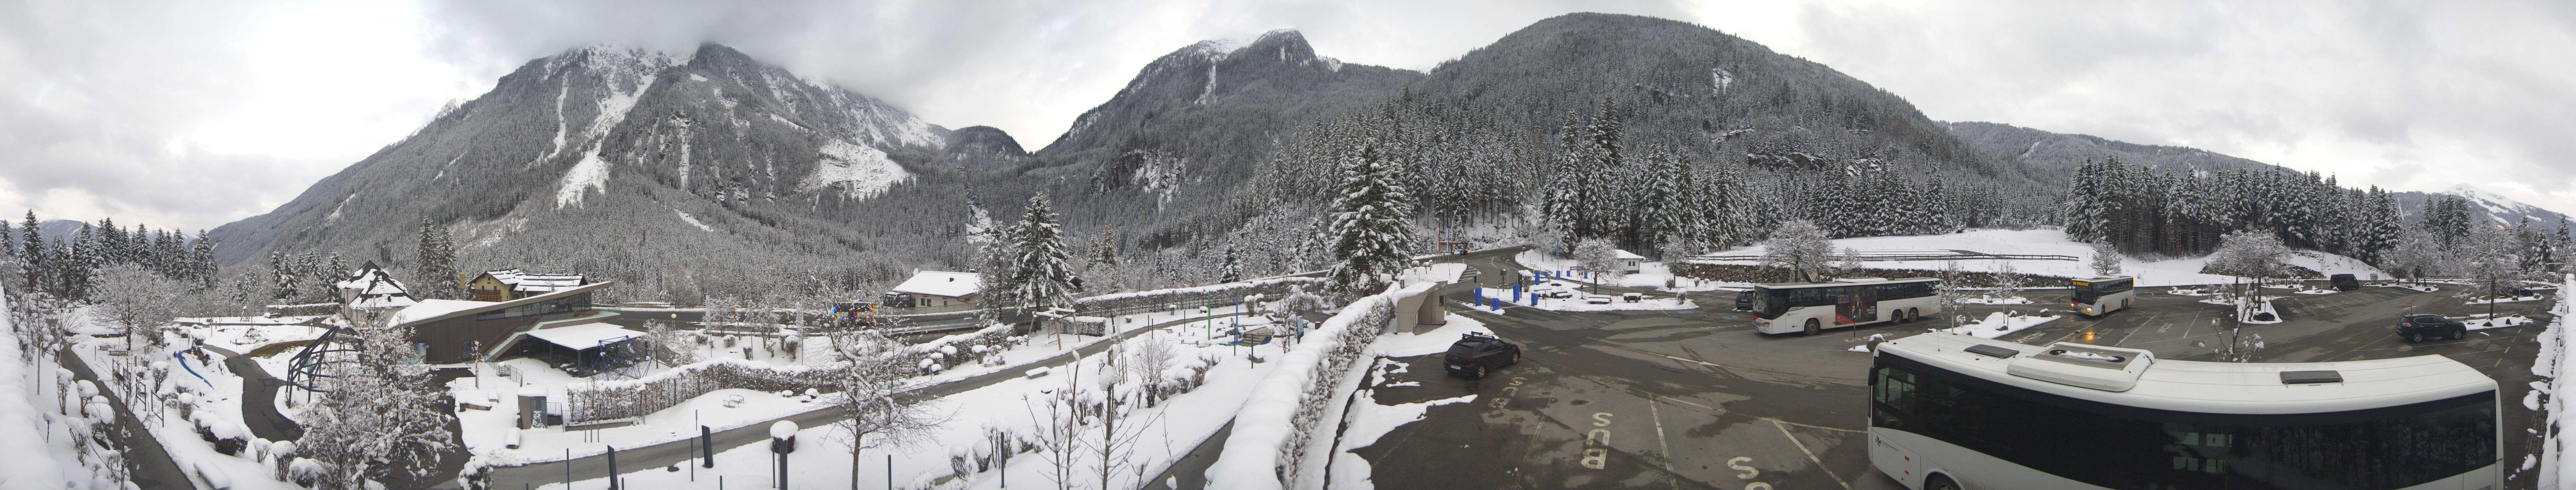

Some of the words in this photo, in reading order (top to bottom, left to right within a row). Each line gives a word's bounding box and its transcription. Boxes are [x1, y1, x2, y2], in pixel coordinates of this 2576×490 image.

[2012, 332, 2046, 343] BUS
[2156, 323, 2173, 333] BUS
[1488, 377, 1527, 409] BUS
[1581, 412, 1613, 469] BUS
